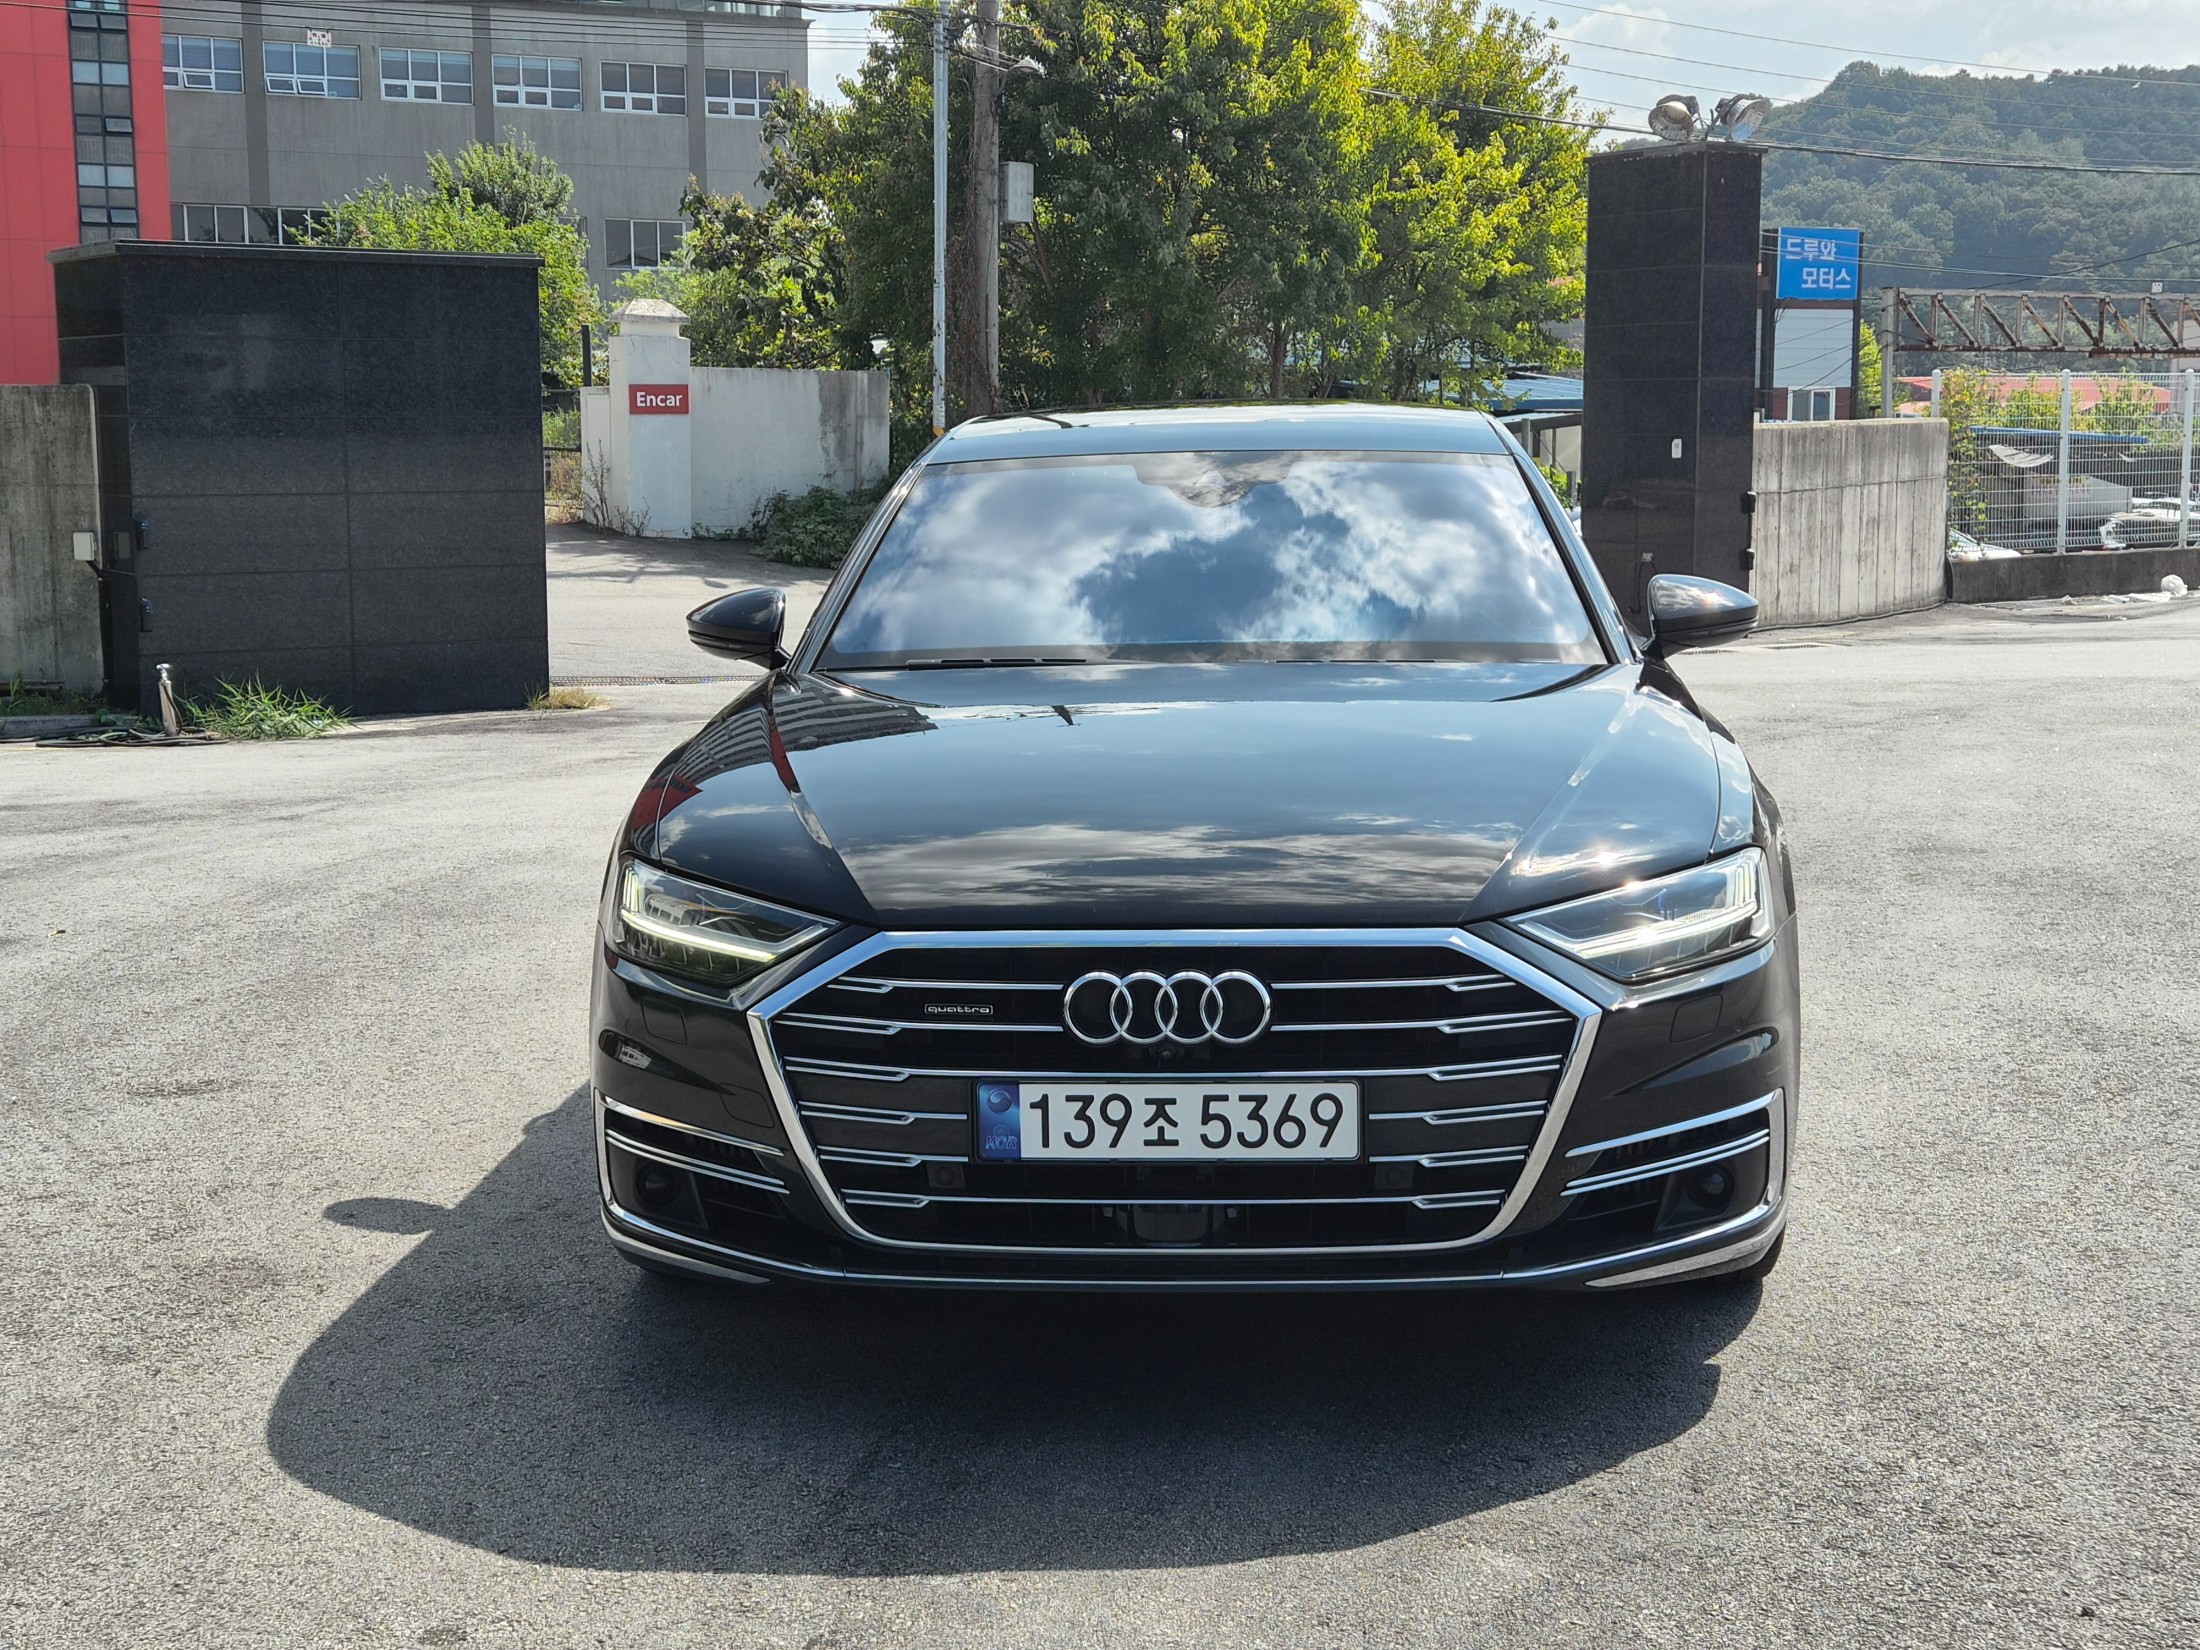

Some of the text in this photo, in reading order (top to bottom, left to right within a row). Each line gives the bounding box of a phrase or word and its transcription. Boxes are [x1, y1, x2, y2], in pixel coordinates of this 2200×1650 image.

[1786, 238, 1837, 261] 드루와
[1801, 267, 1852, 290] 모터스
[636, 391, 683, 407] Encar
[927, 1005, 990, 1014] quattro
[1029, 1093, 1344, 1149] 139조 5369
[985, 1135, 1018, 1150] KOR
